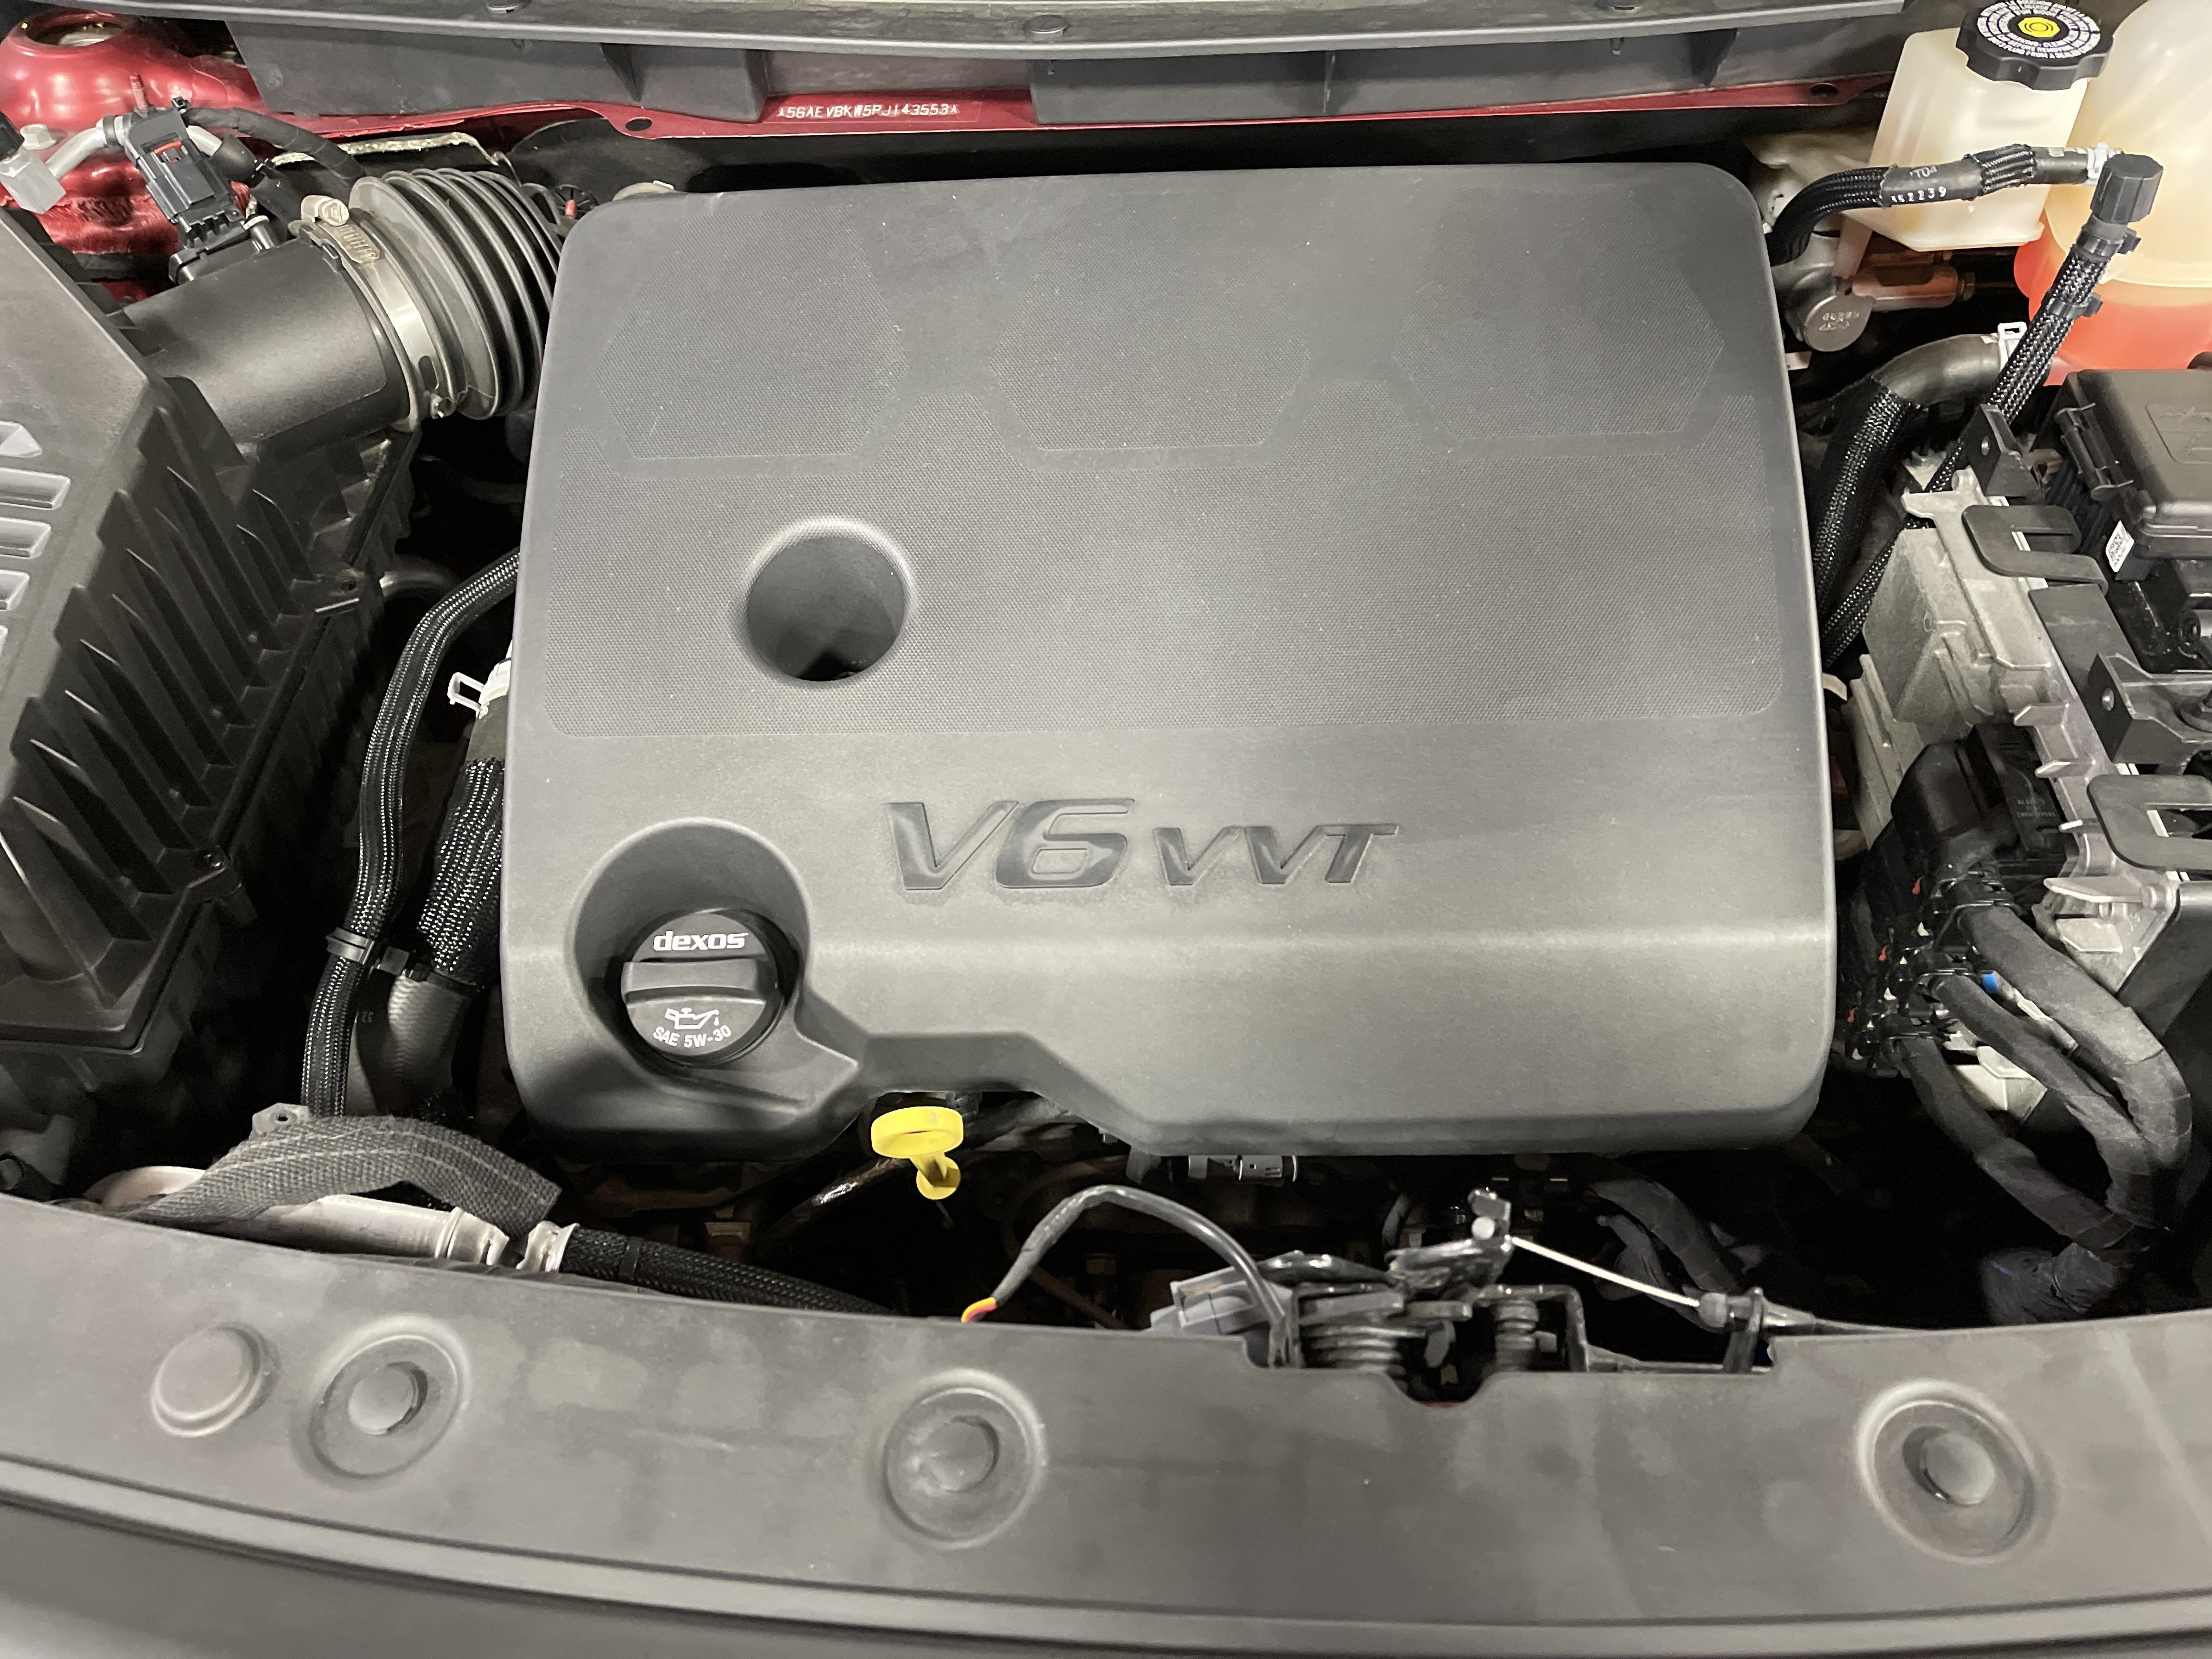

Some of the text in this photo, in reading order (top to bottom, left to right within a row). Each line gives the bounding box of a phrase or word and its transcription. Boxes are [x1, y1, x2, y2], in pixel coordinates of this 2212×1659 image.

[884, 798, 1399, 890] V6 VVT
[653, 930, 749, 951] dexos
[653, 1024, 732, 1048] SAE 5W-30
